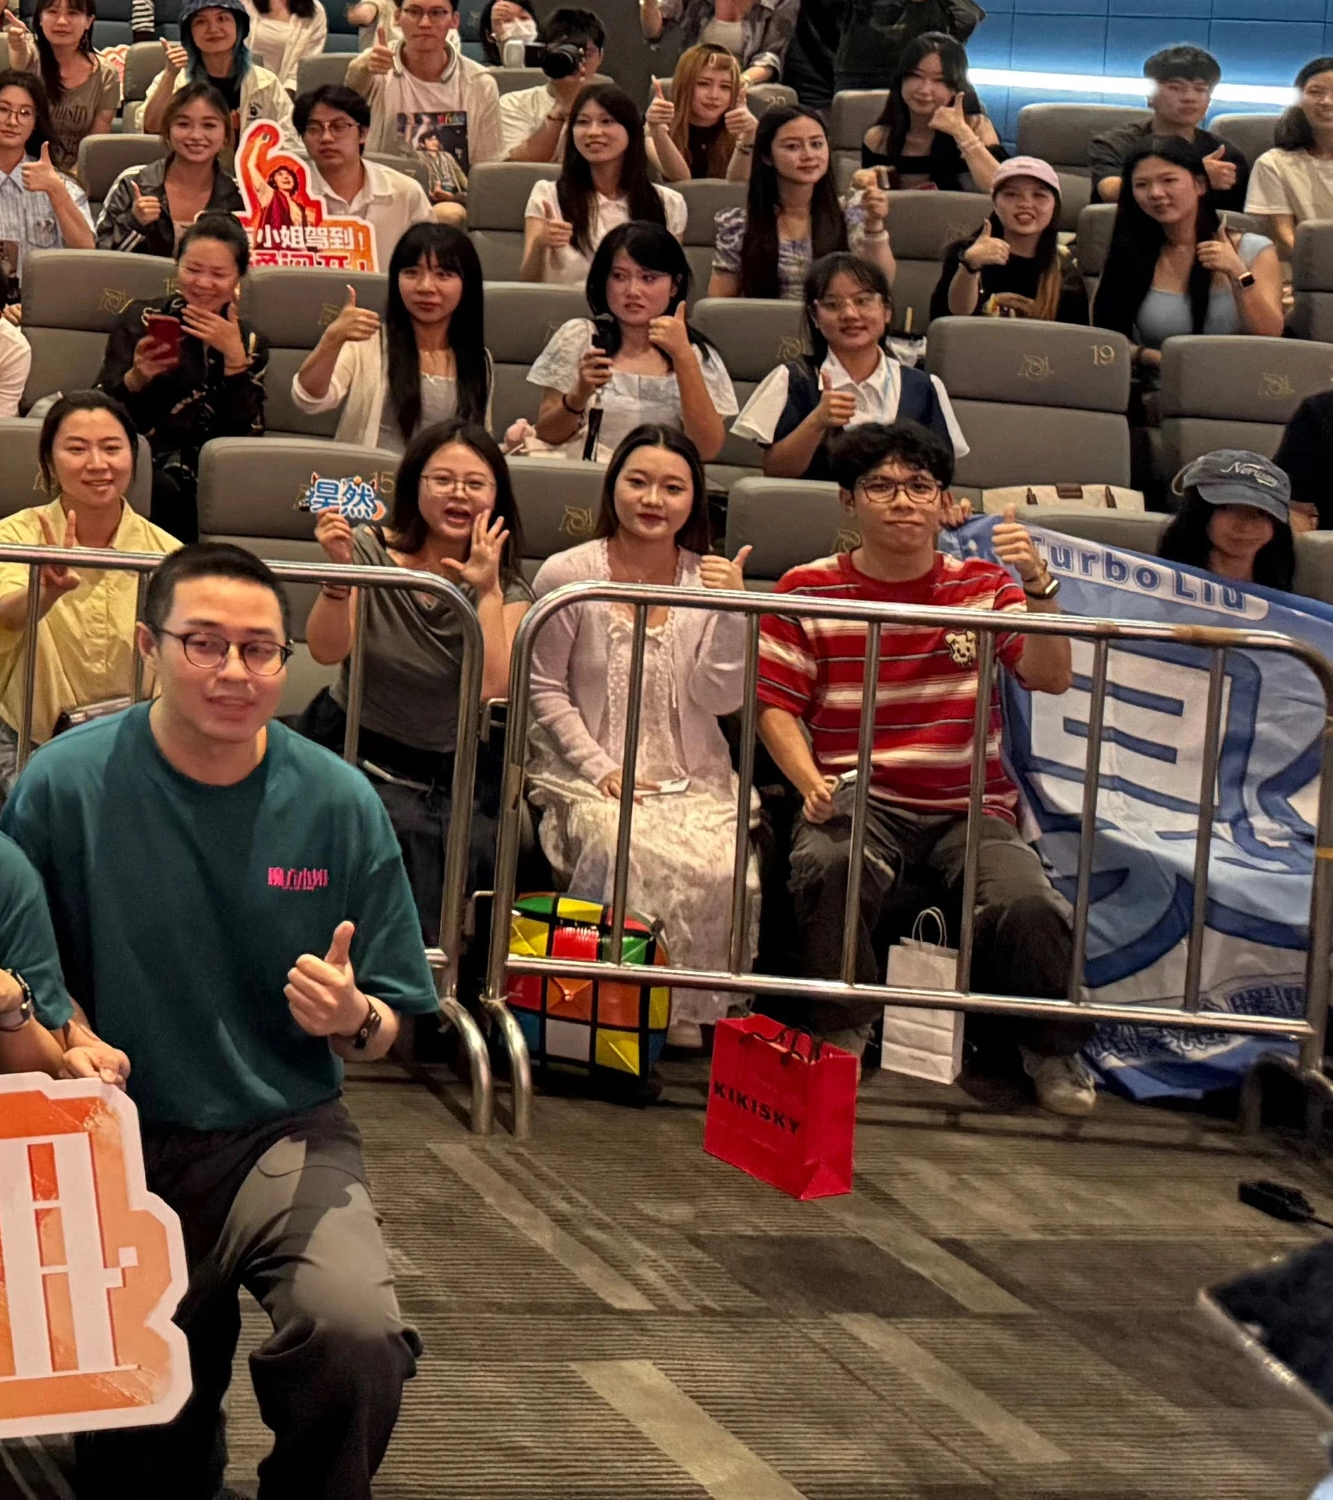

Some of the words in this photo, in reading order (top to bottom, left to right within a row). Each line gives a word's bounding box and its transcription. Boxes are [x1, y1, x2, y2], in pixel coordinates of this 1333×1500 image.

[246, 224, 365, 252] 小姐驾到!
[1089, 345, 1114, 365] 19
[714, 1080, 801, 1134] KIKISKY
